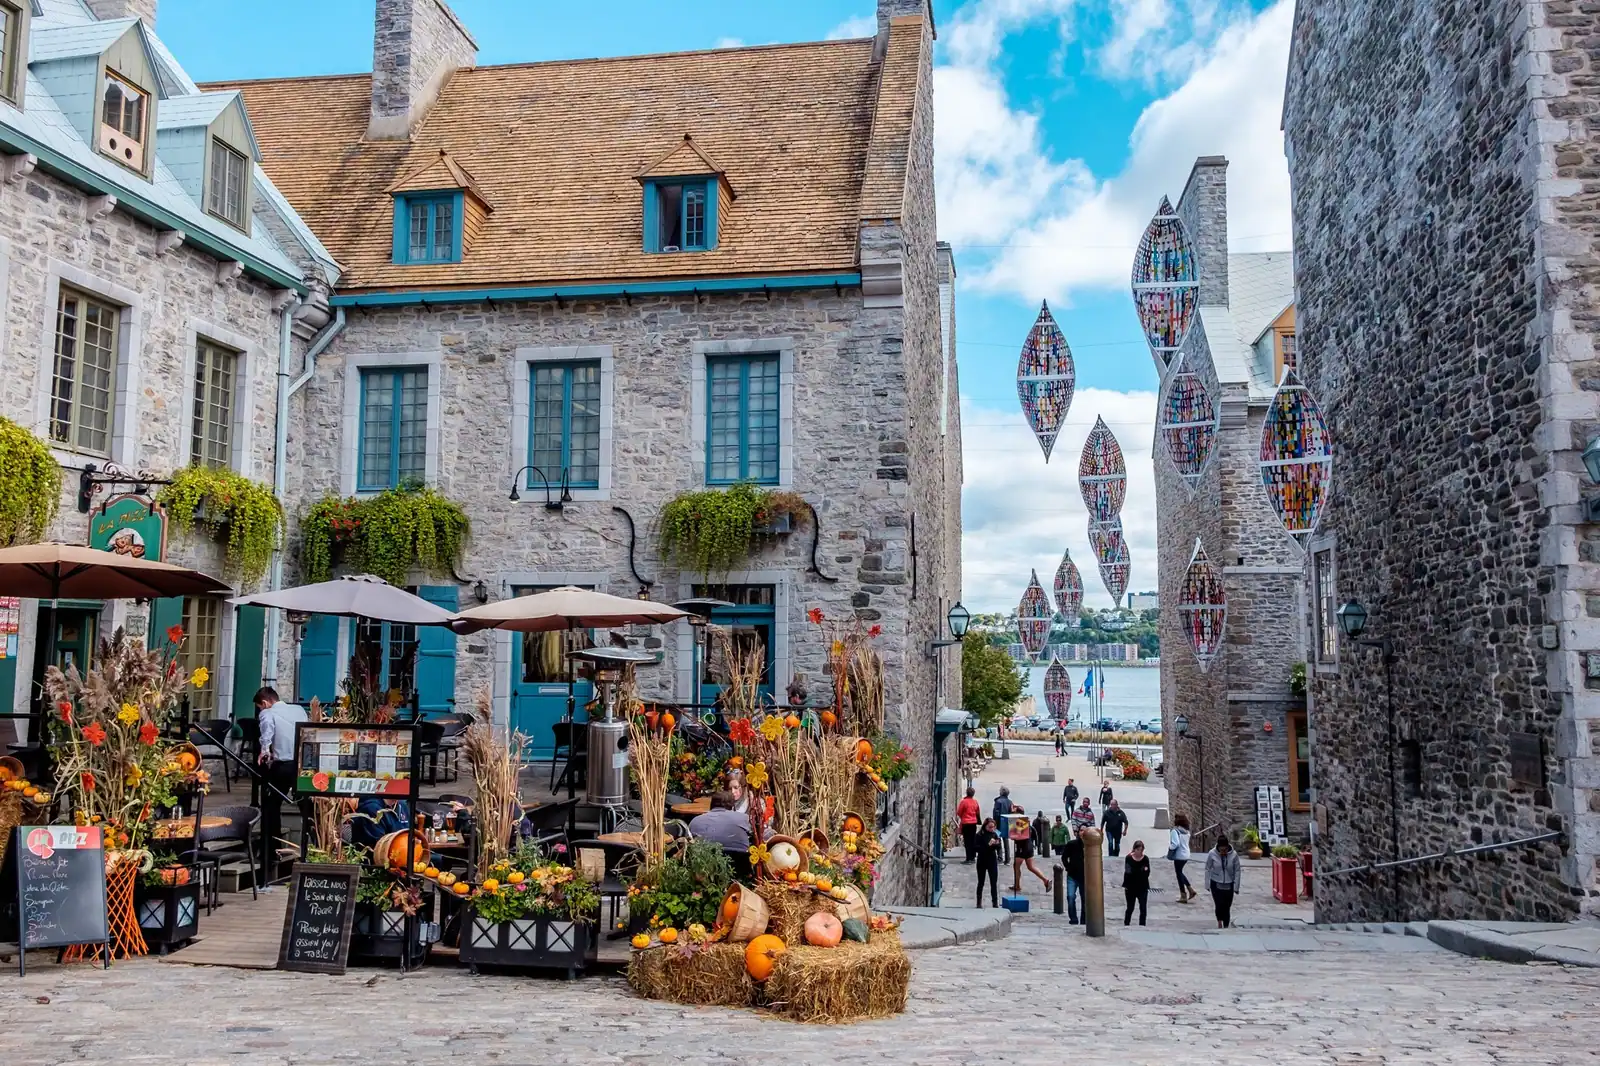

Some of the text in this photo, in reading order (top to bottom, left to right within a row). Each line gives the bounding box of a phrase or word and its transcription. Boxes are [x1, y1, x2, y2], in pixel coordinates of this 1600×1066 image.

[98, 519, 114, 535] LA
[339, 779, 389, 793] LA PIZZ
[59, 831, 88, 846] PIZZ
